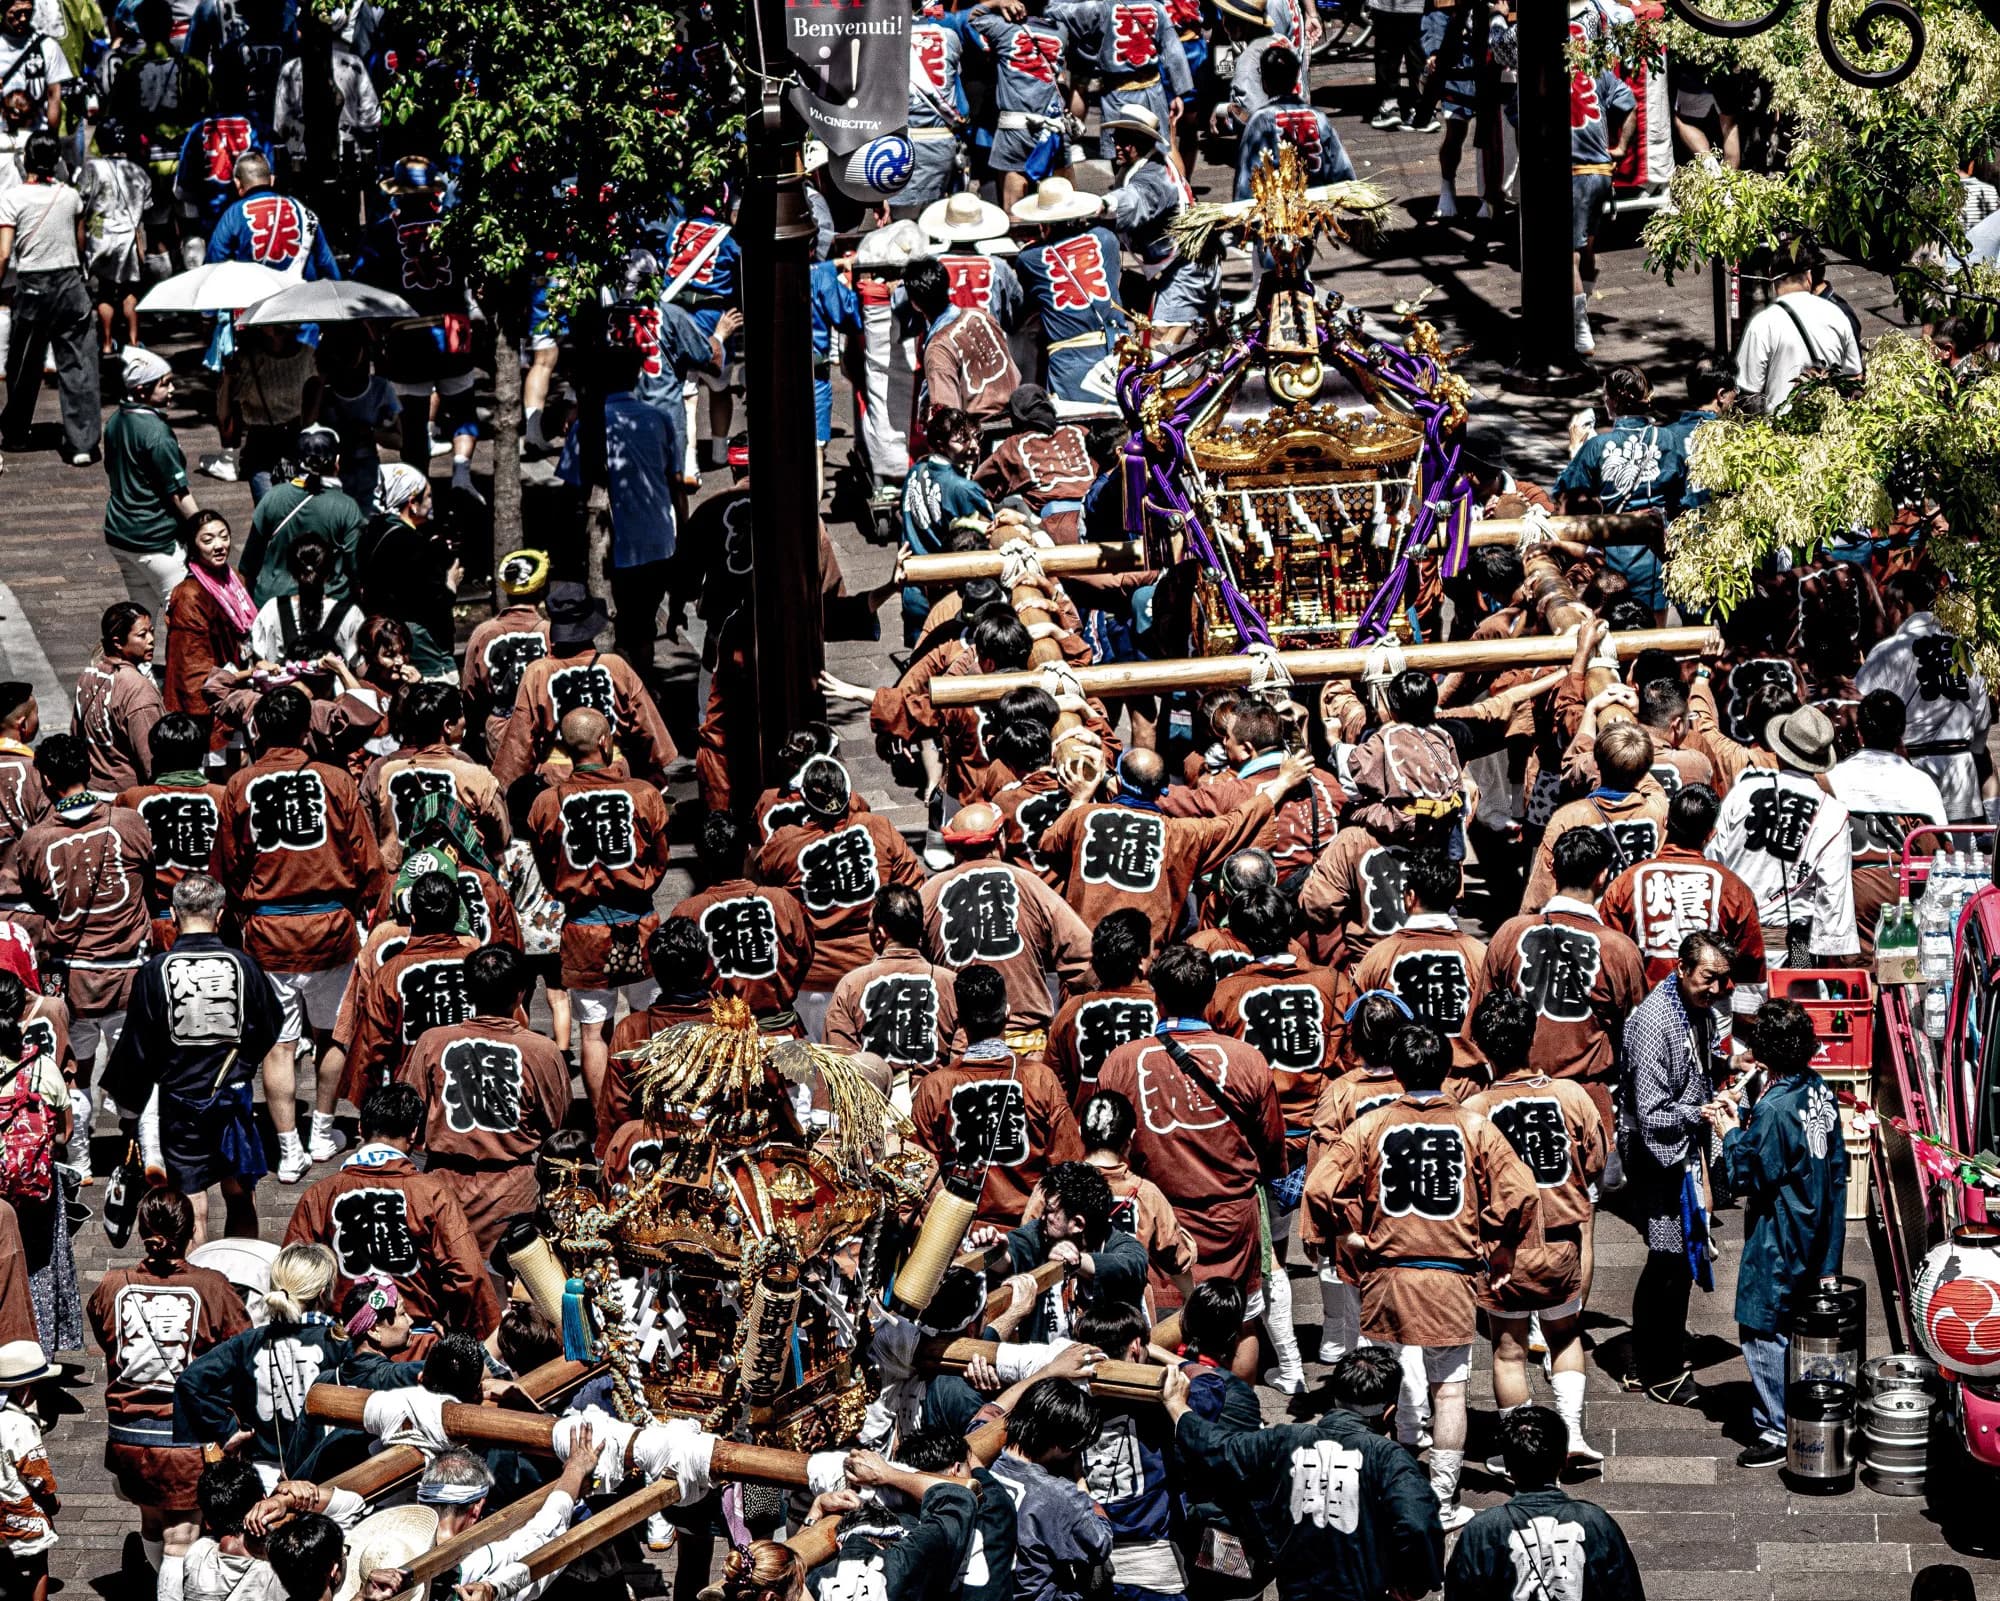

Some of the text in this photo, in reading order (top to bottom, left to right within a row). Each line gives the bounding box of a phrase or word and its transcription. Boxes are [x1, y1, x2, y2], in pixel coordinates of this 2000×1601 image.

[793, 16, 902, 37] Benvenuti!
[809, 106, 882, 130] VIA CINECITTA'
[370, 1290, 386, 1310] 南
